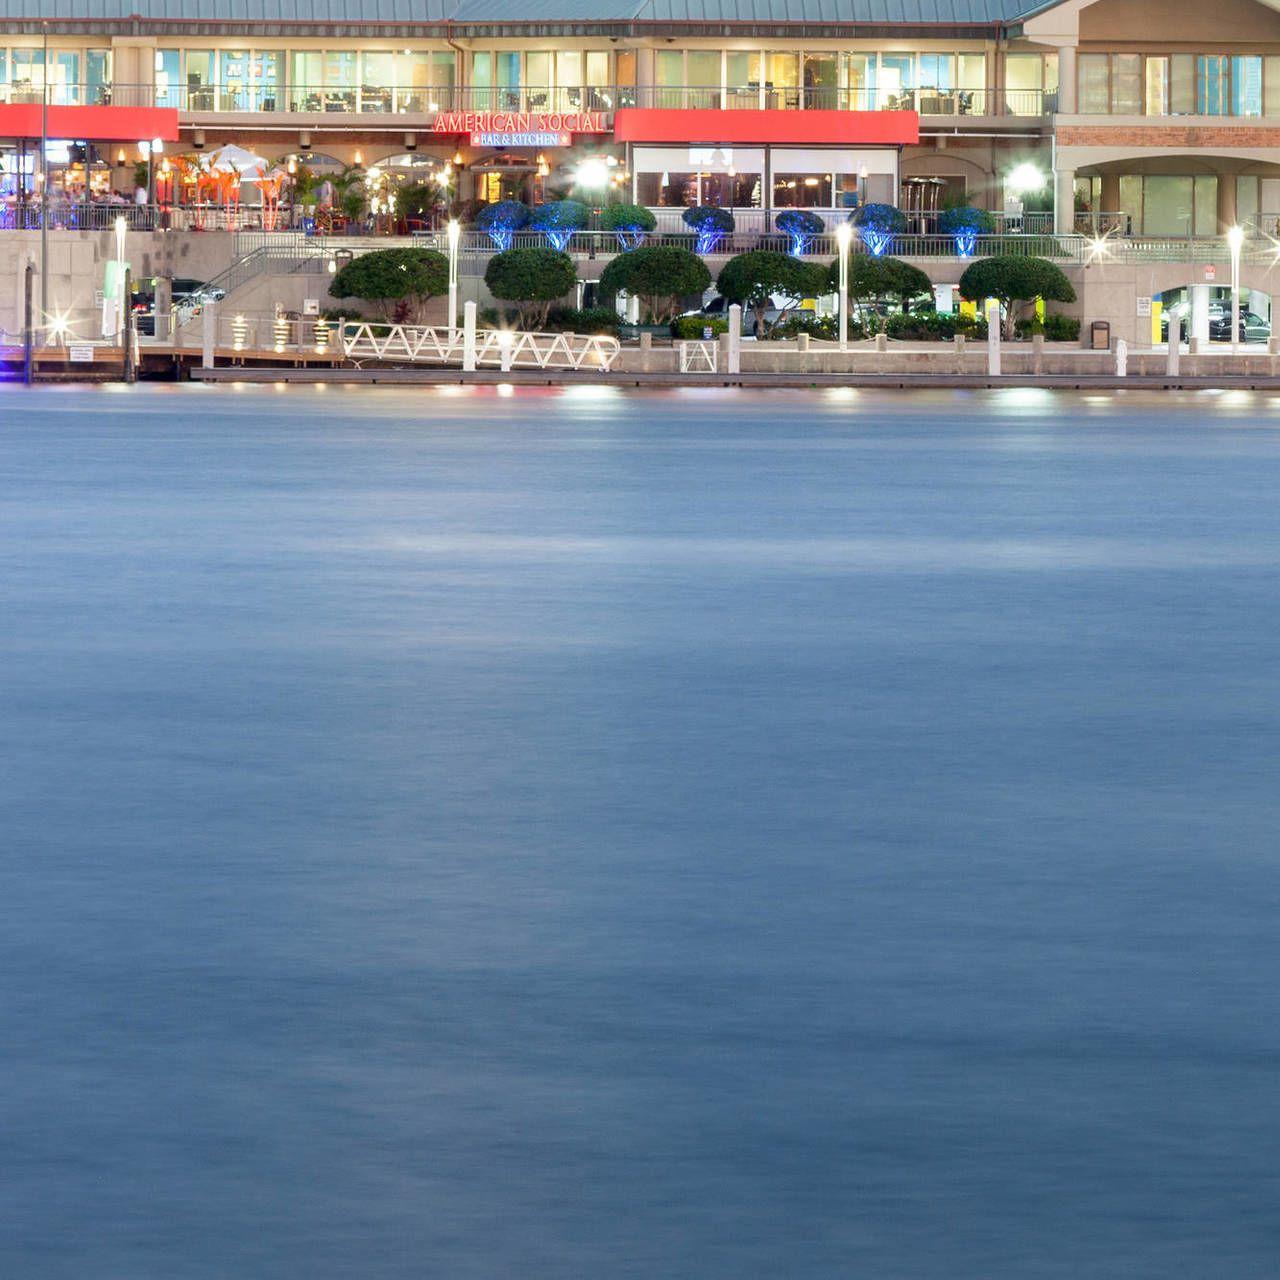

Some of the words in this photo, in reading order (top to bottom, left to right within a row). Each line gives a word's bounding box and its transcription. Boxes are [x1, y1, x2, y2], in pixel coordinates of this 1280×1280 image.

[435, 112, 530, 132] AMERICAN
[538, 111, 604, 132] SOCIAL
[481, 133, 500, 145] BAR
[501, 133, 511, 145] &
[512, 133, 558, 145] KITCHEN
